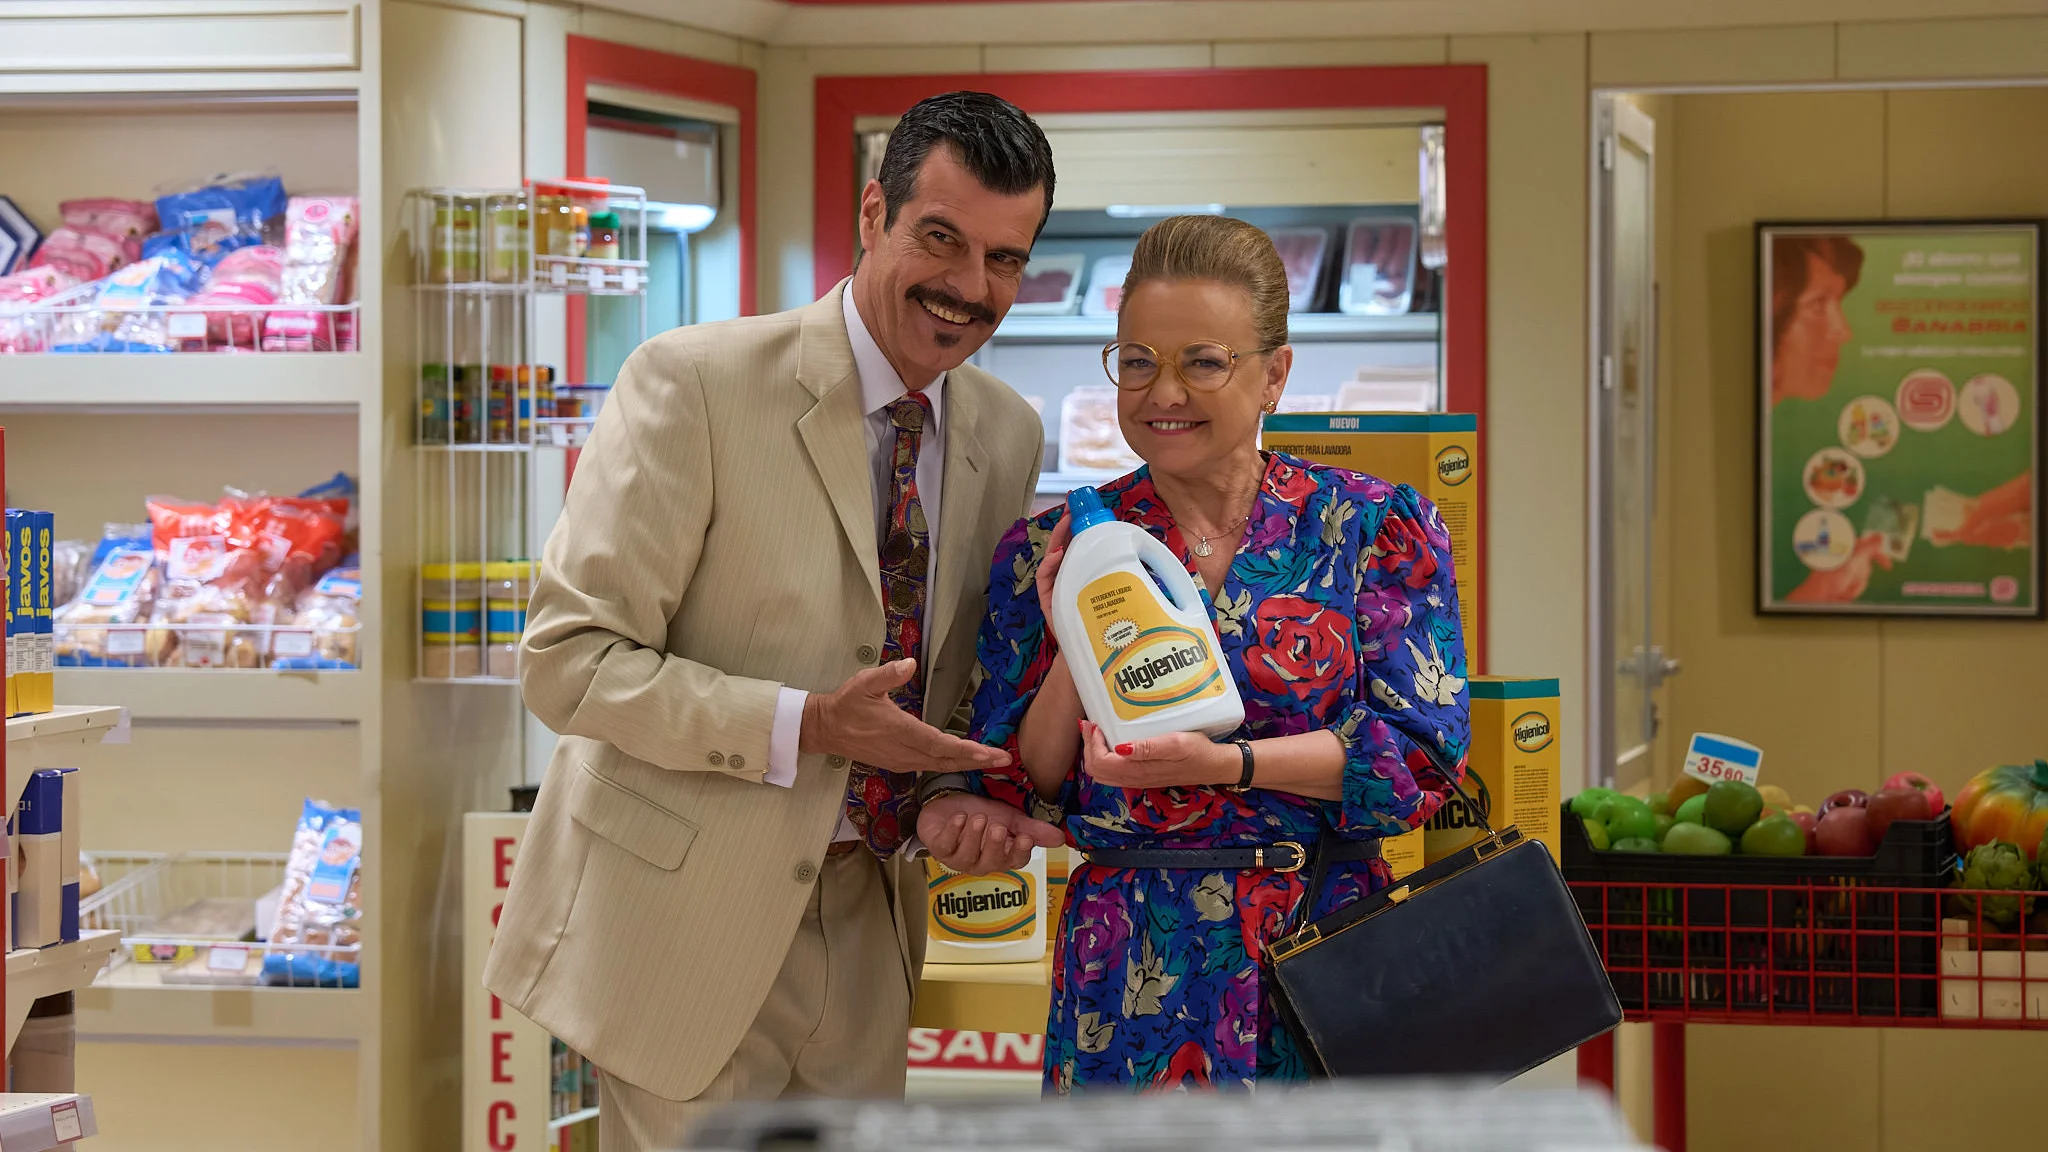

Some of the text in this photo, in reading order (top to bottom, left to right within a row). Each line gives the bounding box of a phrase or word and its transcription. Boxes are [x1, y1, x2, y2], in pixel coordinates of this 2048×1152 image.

[1329, 417, 1359, 430] NUEVO!
[1305, 444, 1320, 456] PARA
[1321, 444, 1352, 456] LAVADORA
[16, 526, 34, 619] javos
[36, 528, 52, 619] javos
[1114, 640, 1208, 693] Higienicol
[1514, 722, 1549, 742] Higienicol
[937, 884, 1029, 919] Higienicol
